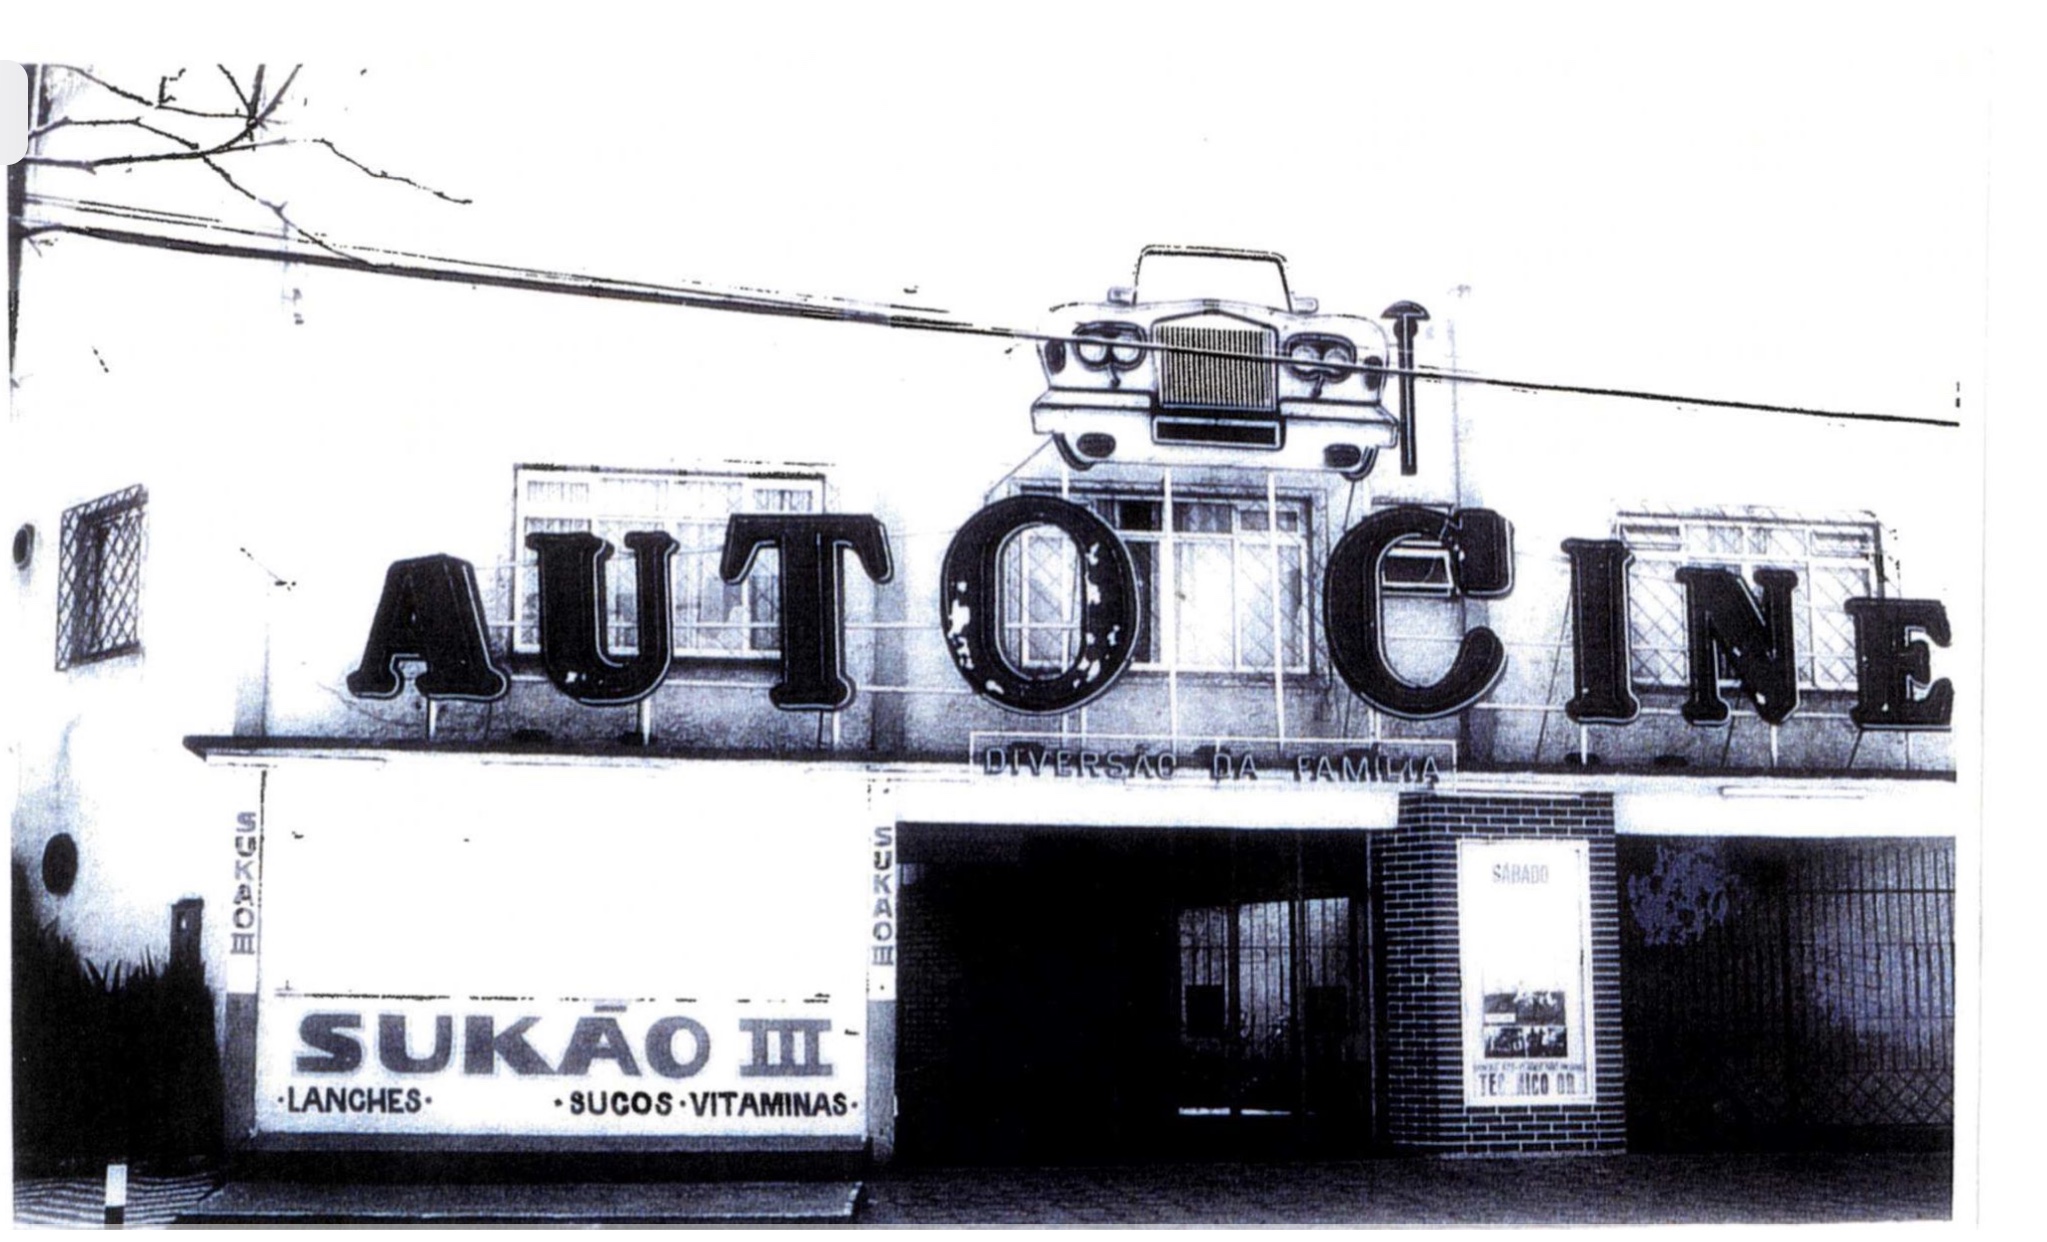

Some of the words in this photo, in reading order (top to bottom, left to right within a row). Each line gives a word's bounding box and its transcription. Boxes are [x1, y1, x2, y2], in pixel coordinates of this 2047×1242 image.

[346, 495, 1142, 716] AUTO
[1322, 505, 1956, 732] CINE
[983, 744, 1178, 780] DIVERSÃO
[1209, 752, 1258, 781] DA
[296, 1005, 711, 1078] SUKÃO
[738, 1018, 833, 1076] III
[287, 1086, 423, 1114] LANCHES
[569, 1090, 674, 1117] SUCOS
[689, 1091, 848, 1118] VITAMINAS
